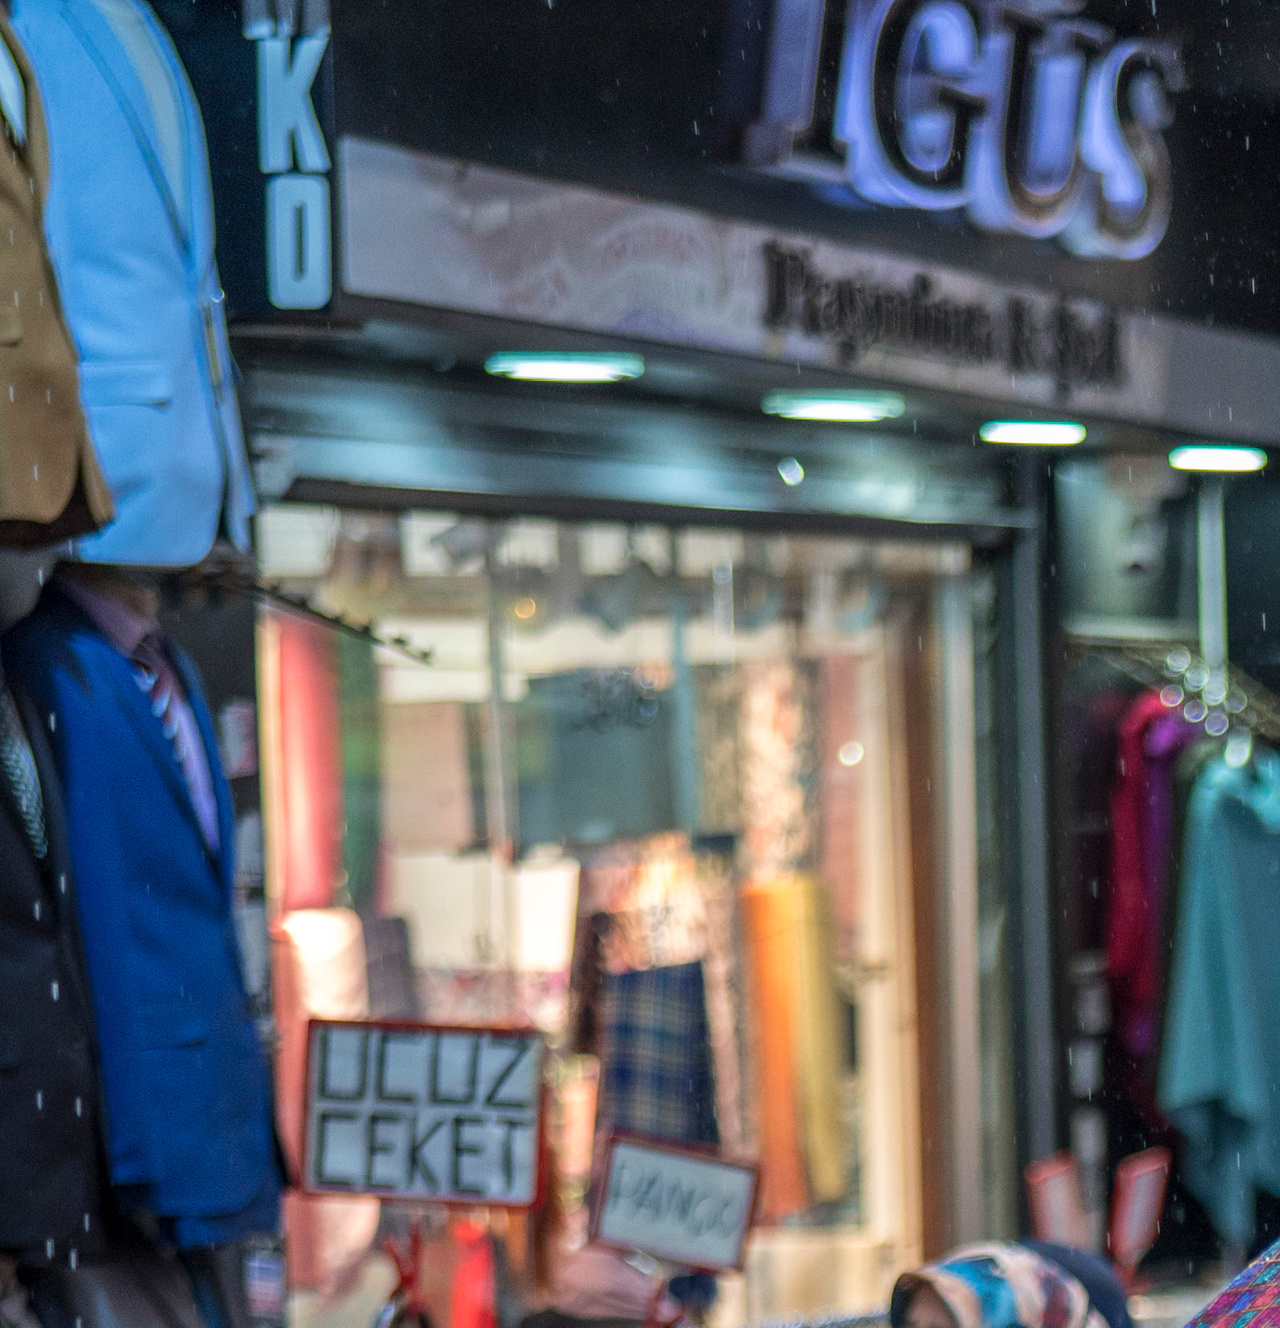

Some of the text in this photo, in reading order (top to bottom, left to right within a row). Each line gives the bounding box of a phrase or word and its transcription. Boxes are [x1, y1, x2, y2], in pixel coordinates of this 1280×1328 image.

[243, 0, 331, 310] KO
[317, 1030, 530, 1107] UCUZ
[314, 1112, 533, 1195] CEKET
